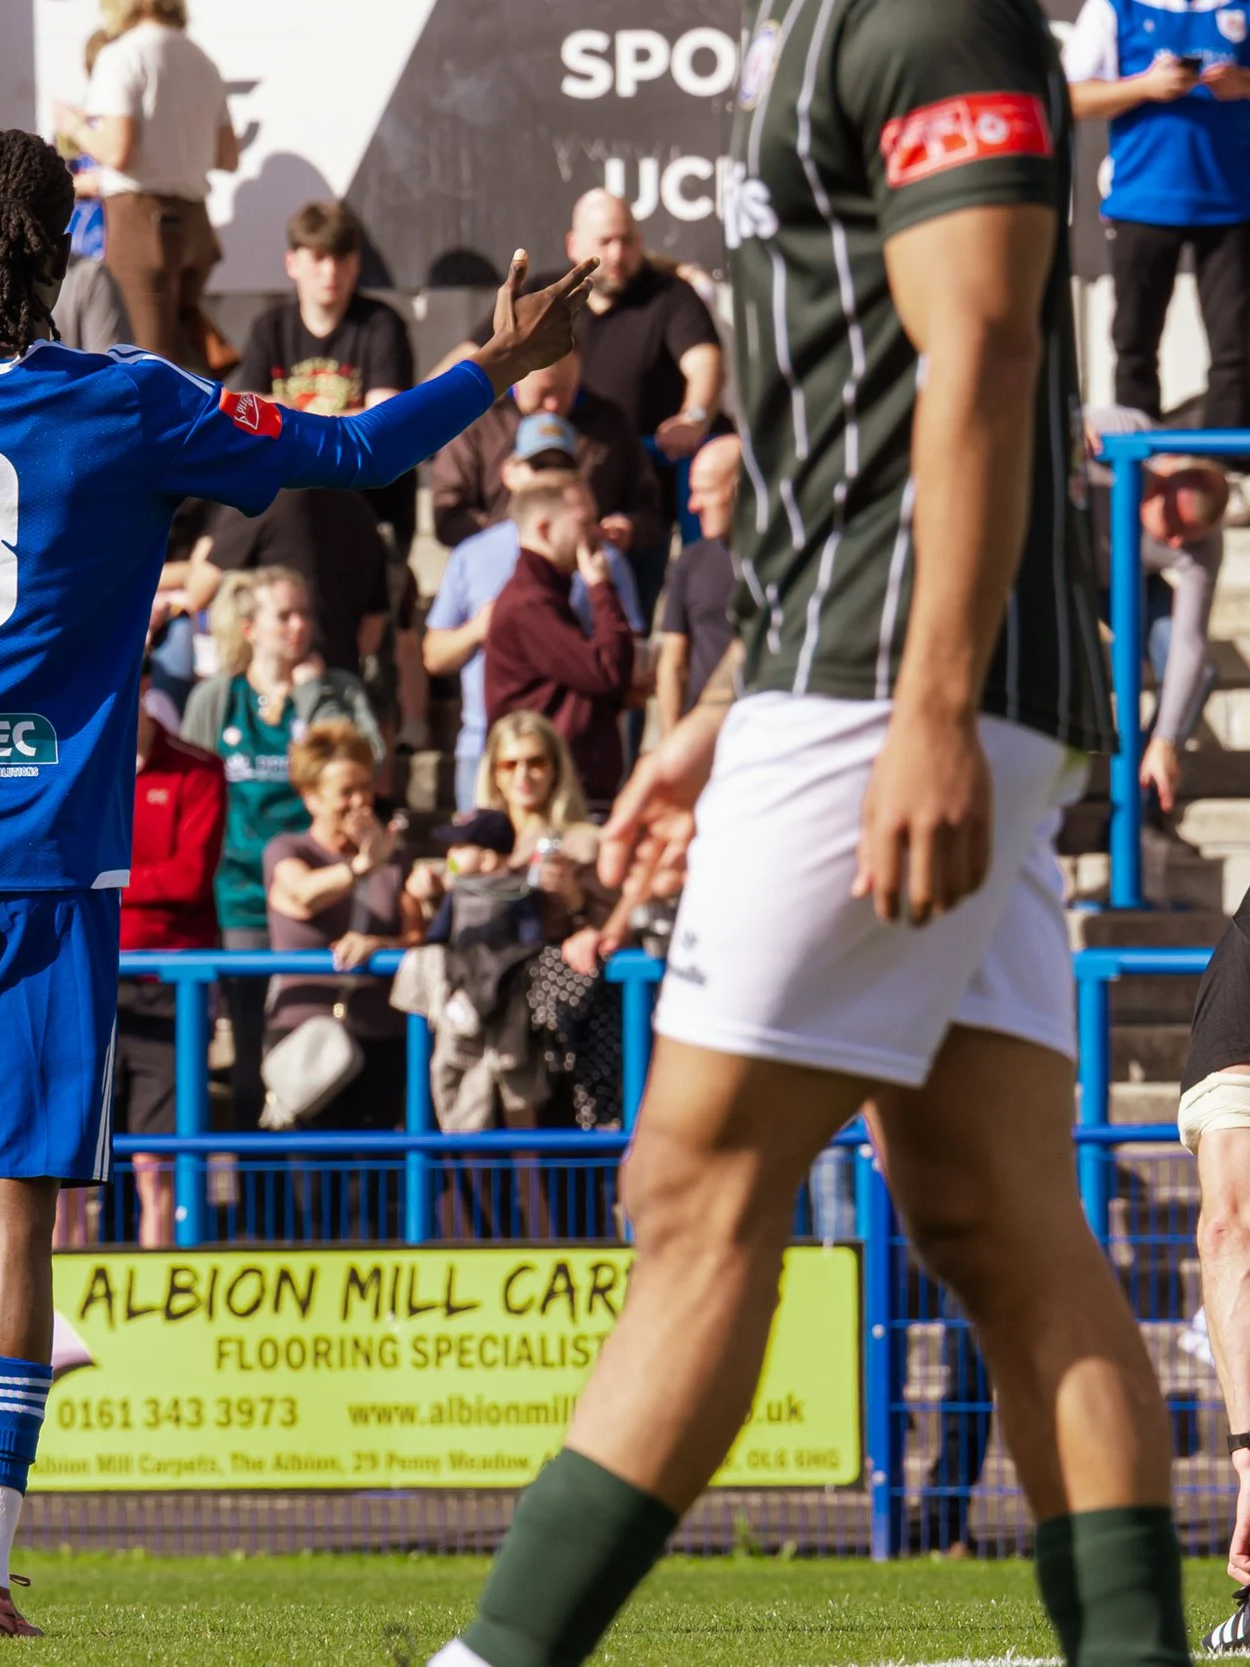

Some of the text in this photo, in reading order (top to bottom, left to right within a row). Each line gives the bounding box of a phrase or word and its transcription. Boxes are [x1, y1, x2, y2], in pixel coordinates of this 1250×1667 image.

[561, 27, 749, 99] SPO
[605, 155, 733, 221] UC
[78, 1259, 634, 1331] ALBION MILL CAR
[216, 1335, 398, 1370] FLOORING
[58, 1400, 132, 1430] 0161
[144, 1399, 203, 1429] 343
[216, 1396, 299, 1428] 3973
[230, 1452, 263, 1473] The
